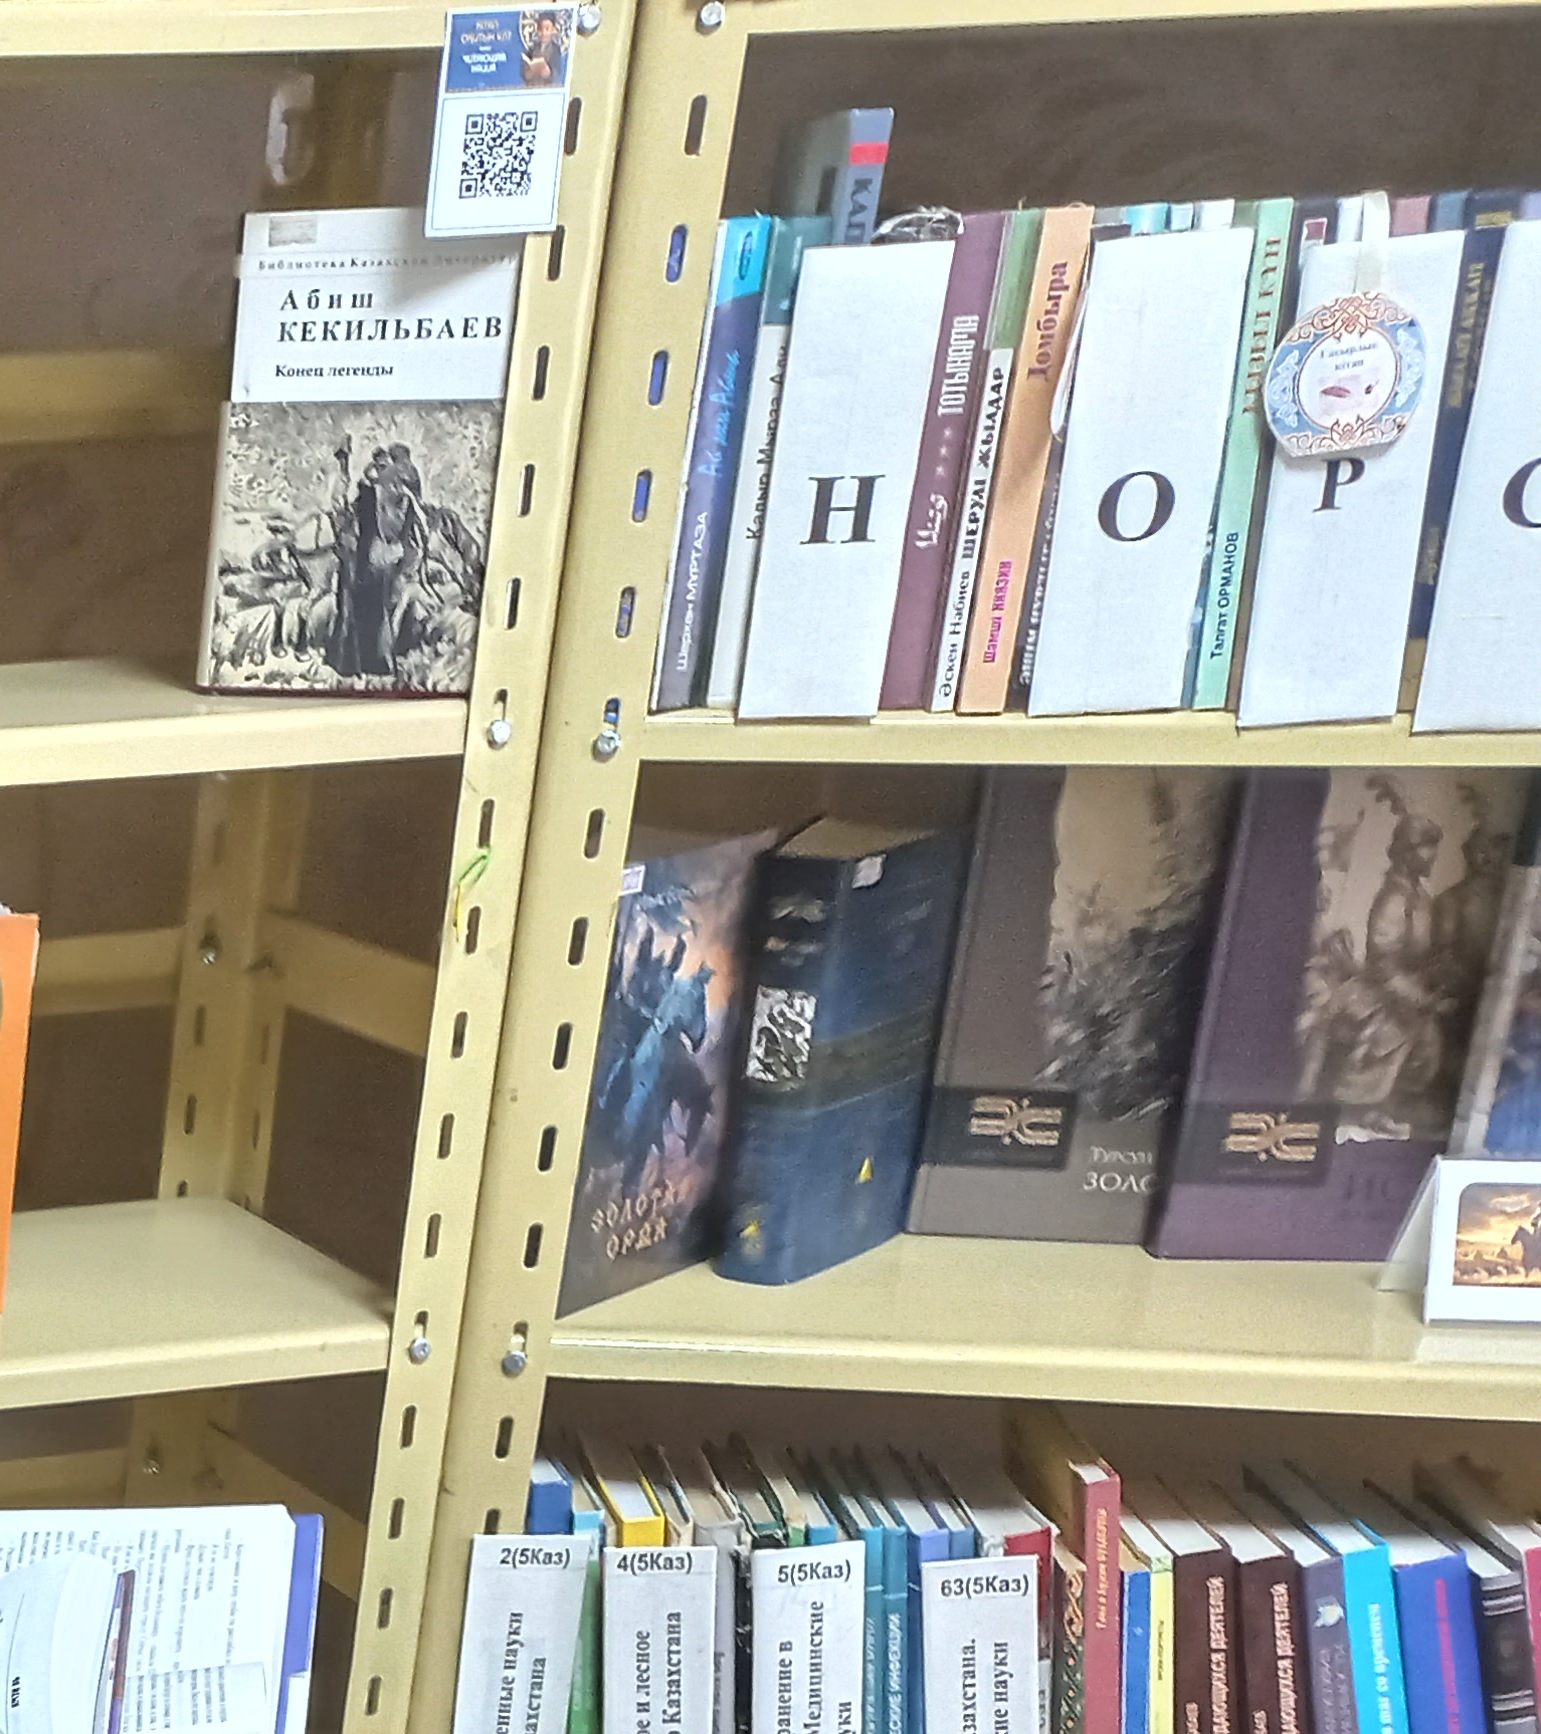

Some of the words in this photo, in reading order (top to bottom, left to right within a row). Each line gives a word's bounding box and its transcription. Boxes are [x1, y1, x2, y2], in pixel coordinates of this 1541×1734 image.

[277, 316, 502, 343] КЕКИЛЬБАЕВ
[280, 289, 373, 311] Абиш
[1026, 257, 1072, 384] Домбыра
[275, 365, 324, 378] Конец
[327, 365, 394, 377] легенды
[970, 393, 1002, 489] ЖЫЛДАР
[800, 475, 886, 546] Н
[1097, 470, 1177, 542] О
[1312, 459, 1366, 513] Р
[1214, 531, 1240, 609] ОРМАНОВ
[672, 602, 698, 671] Шерхан
[498, 1545, 573, 1567] 2(5Каз)
[617, 1551, 695, 1573] 4(5Каз)
[777, 1558, 853, 1583] 5(5Каз)
[939, 1573, 1030, 1598] 63(5Каз)
[500, 1610, 528, 1671] науки
[1206, 1576, 1227, 1649] ДЕЯТЕЛЕЙ
[1270, 1583, 1292, 1657] ДЕЯТЕЛЕЙ
[632, 1630, 652, 1695] лесное
[659, 1611, 683, 1723] Казахстана
[777, 1641, 792, 1652] в
[887, 1614, 901, 1691] ИНФЕКЦИИ
[991, 1641, 1016, 1702] науки
[636, 1701, 650, 1713] и
